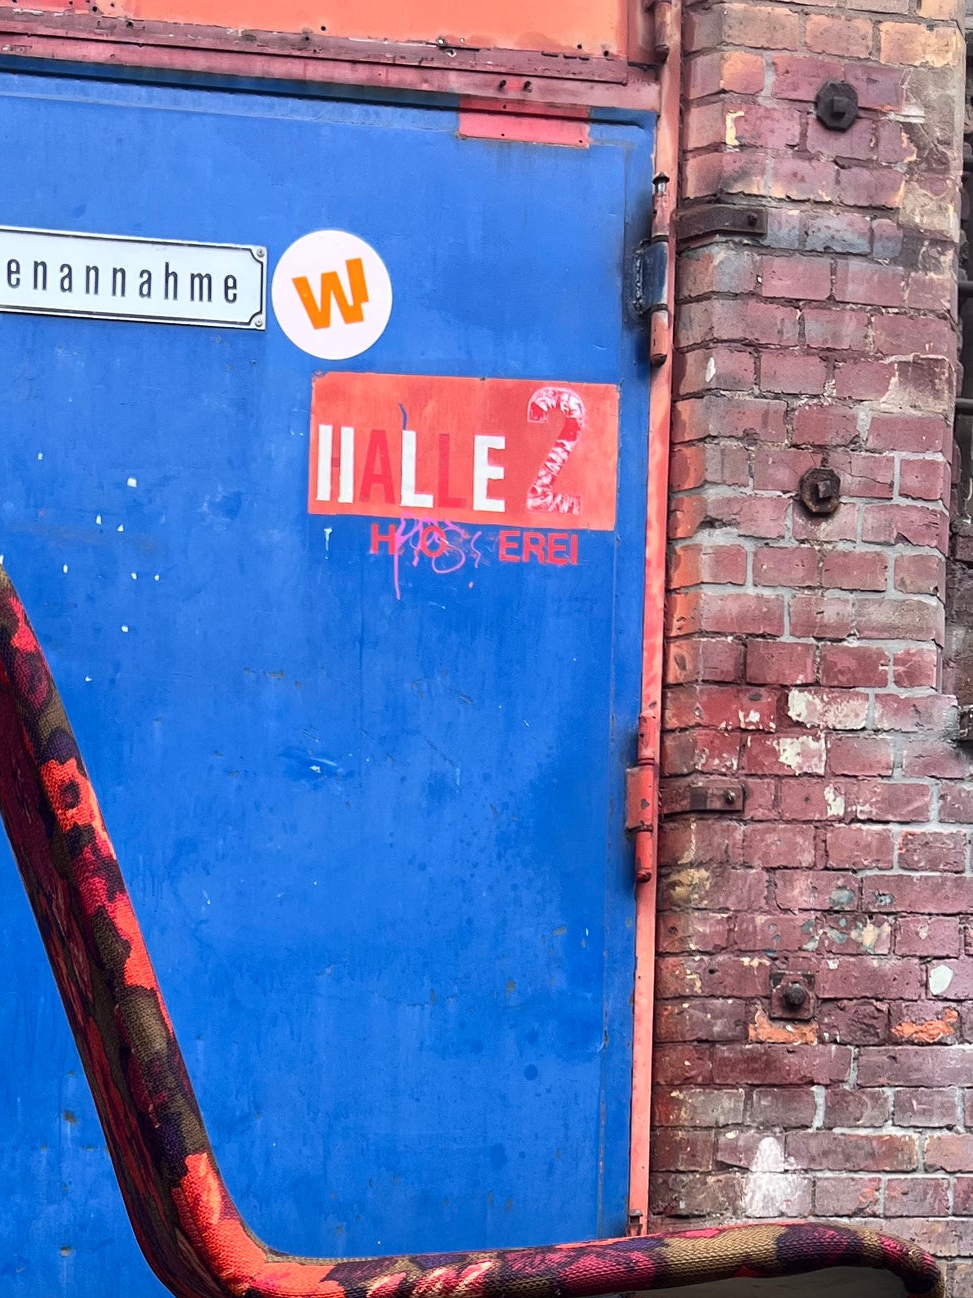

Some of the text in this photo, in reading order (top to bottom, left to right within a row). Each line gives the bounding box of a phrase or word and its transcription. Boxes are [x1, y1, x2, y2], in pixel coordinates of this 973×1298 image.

[292, 257, 369, 330] W
[316, 386, 585, 515] HALLE 2
